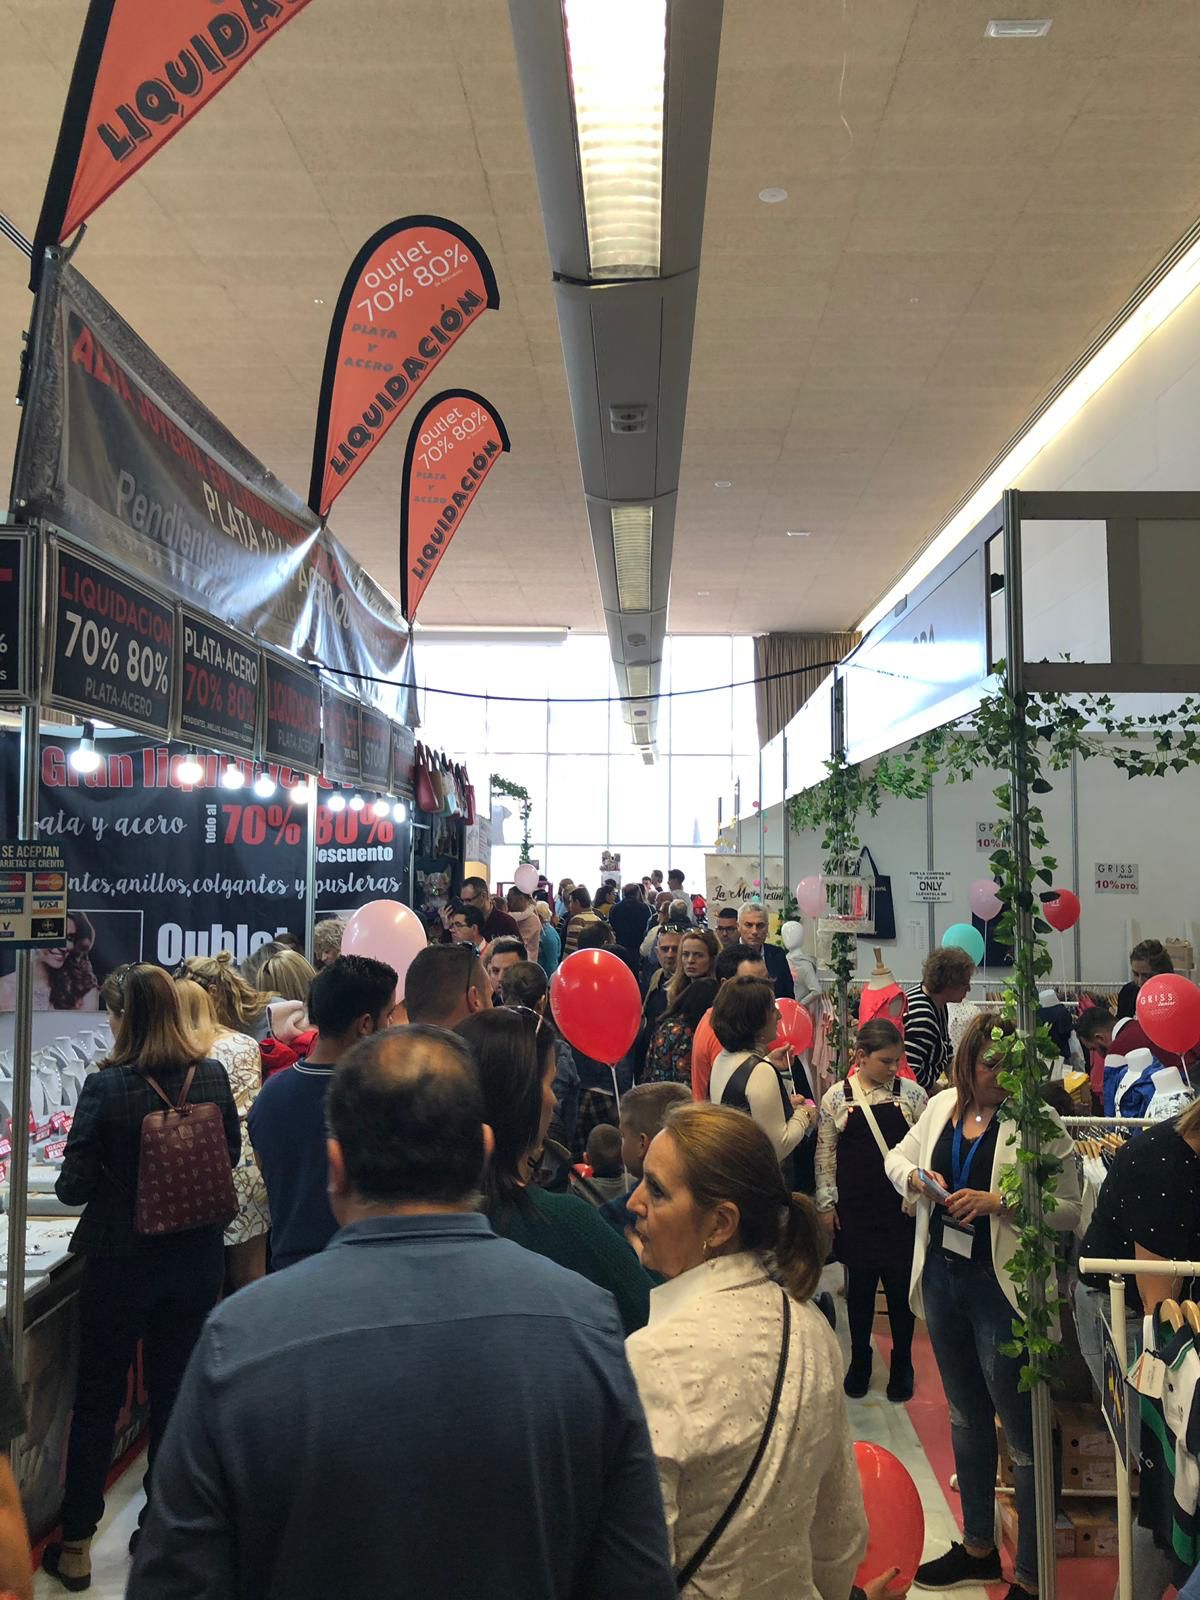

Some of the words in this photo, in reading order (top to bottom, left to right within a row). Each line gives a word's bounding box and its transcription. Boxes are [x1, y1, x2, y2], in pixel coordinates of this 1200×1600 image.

[97, 0, 290, 161] LIQUIDA
[364, 240, 431, 289] outlet
[357, 278, 413, 322] 70%
[413, 244, 468, 287] 80%
[351, 323, 397, 340] PLATA
[344, 357, 393, 372] ACERO
[330, 289, 484, 475] LIQUIDACIÓN
[418, 436, 454, 469] 70%
[452, 408, 487, 440] 80%
[421, 408, 463, 445] outlet
[202, 480, 260, 557] PLATA
[412, 440, 499, 580] LIQUIDACIÓN
[60, 566, 173, 648] LIQUIDACION
[65, 611, 119, 675] 70%
[127, 640, 168, 695] 80%
[184, 663, 223, 712] 70%
[38, 809, 85, 836] ata
[92, 816, 108, 841] y
[115, 814, 188, 837] acero
[206, 804, 217, 815] al
[222, 804, 301, 845] 70%
[205, 817, 217, 844] todo
[977, 839, 1000, 848] 10%
[0, 860, 27, 868] ARJETAS
[2, 845, 14, 858] SE
[16, 845, 60, 858] ACEPTAN
[1098, 863, 1132, 873] GRISS
[919, 881, 943, 891] ONLY
[39, 900, 59, 909] VISA
[1140, 992, 1173, 1005] GRISS
